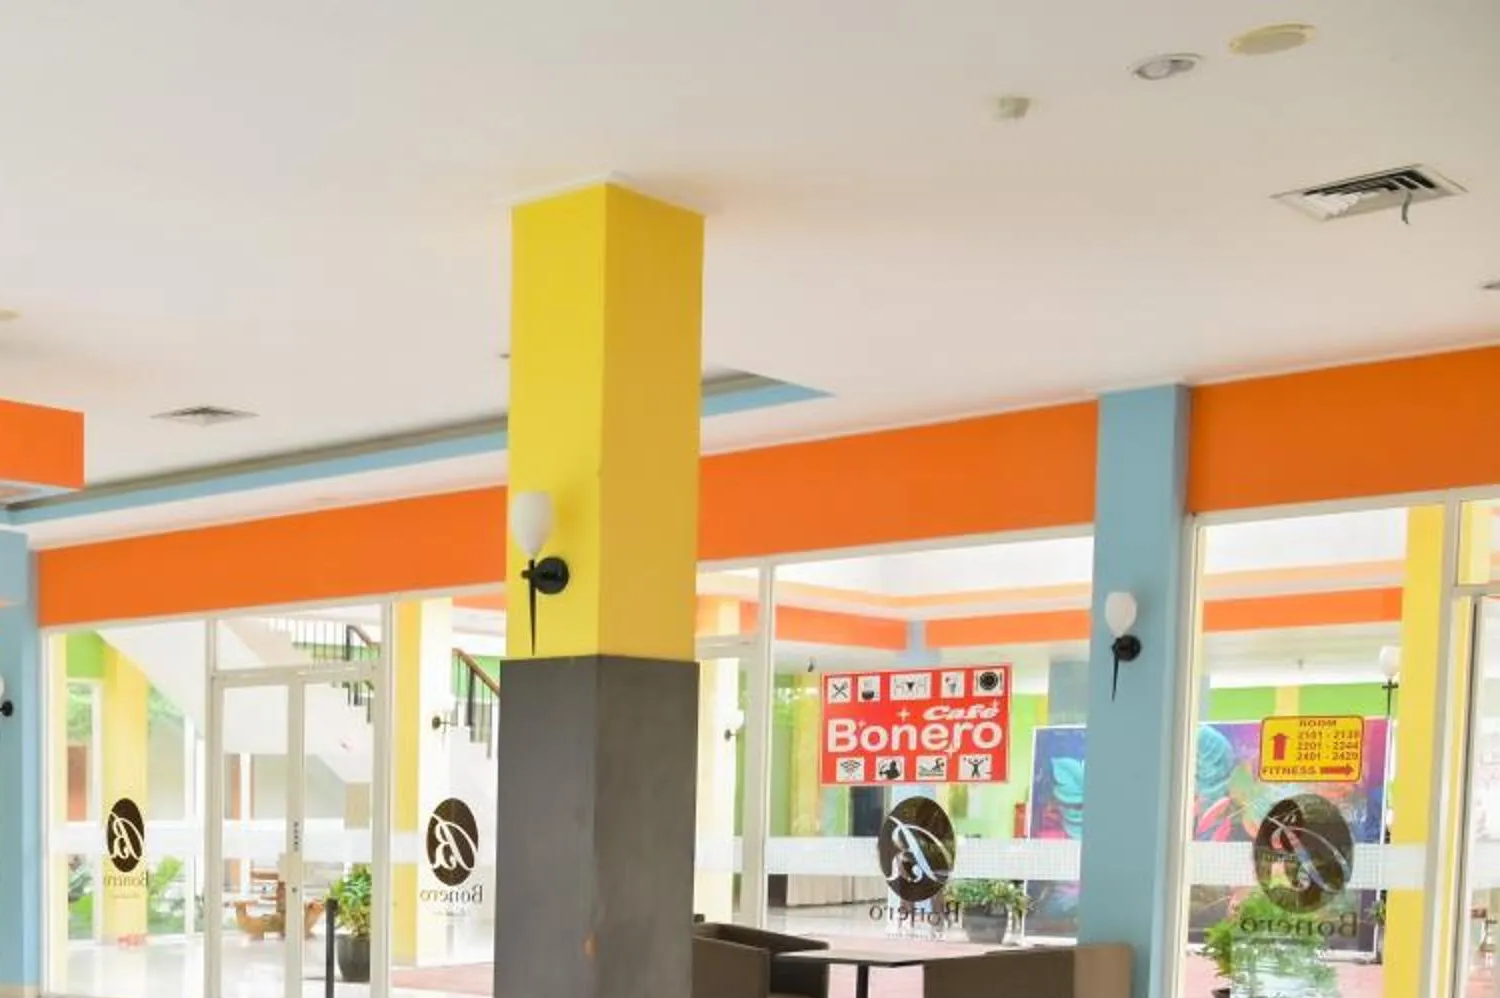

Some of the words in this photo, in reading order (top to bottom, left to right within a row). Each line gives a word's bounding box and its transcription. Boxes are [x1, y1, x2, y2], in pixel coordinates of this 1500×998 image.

[1299, 719, 1337, 727] ROOM
[827, 718, 1003, 752] Bonero
[1296, 751, 1321, 761] 2401
[1262, 766, 1317, 775] FITNESS
